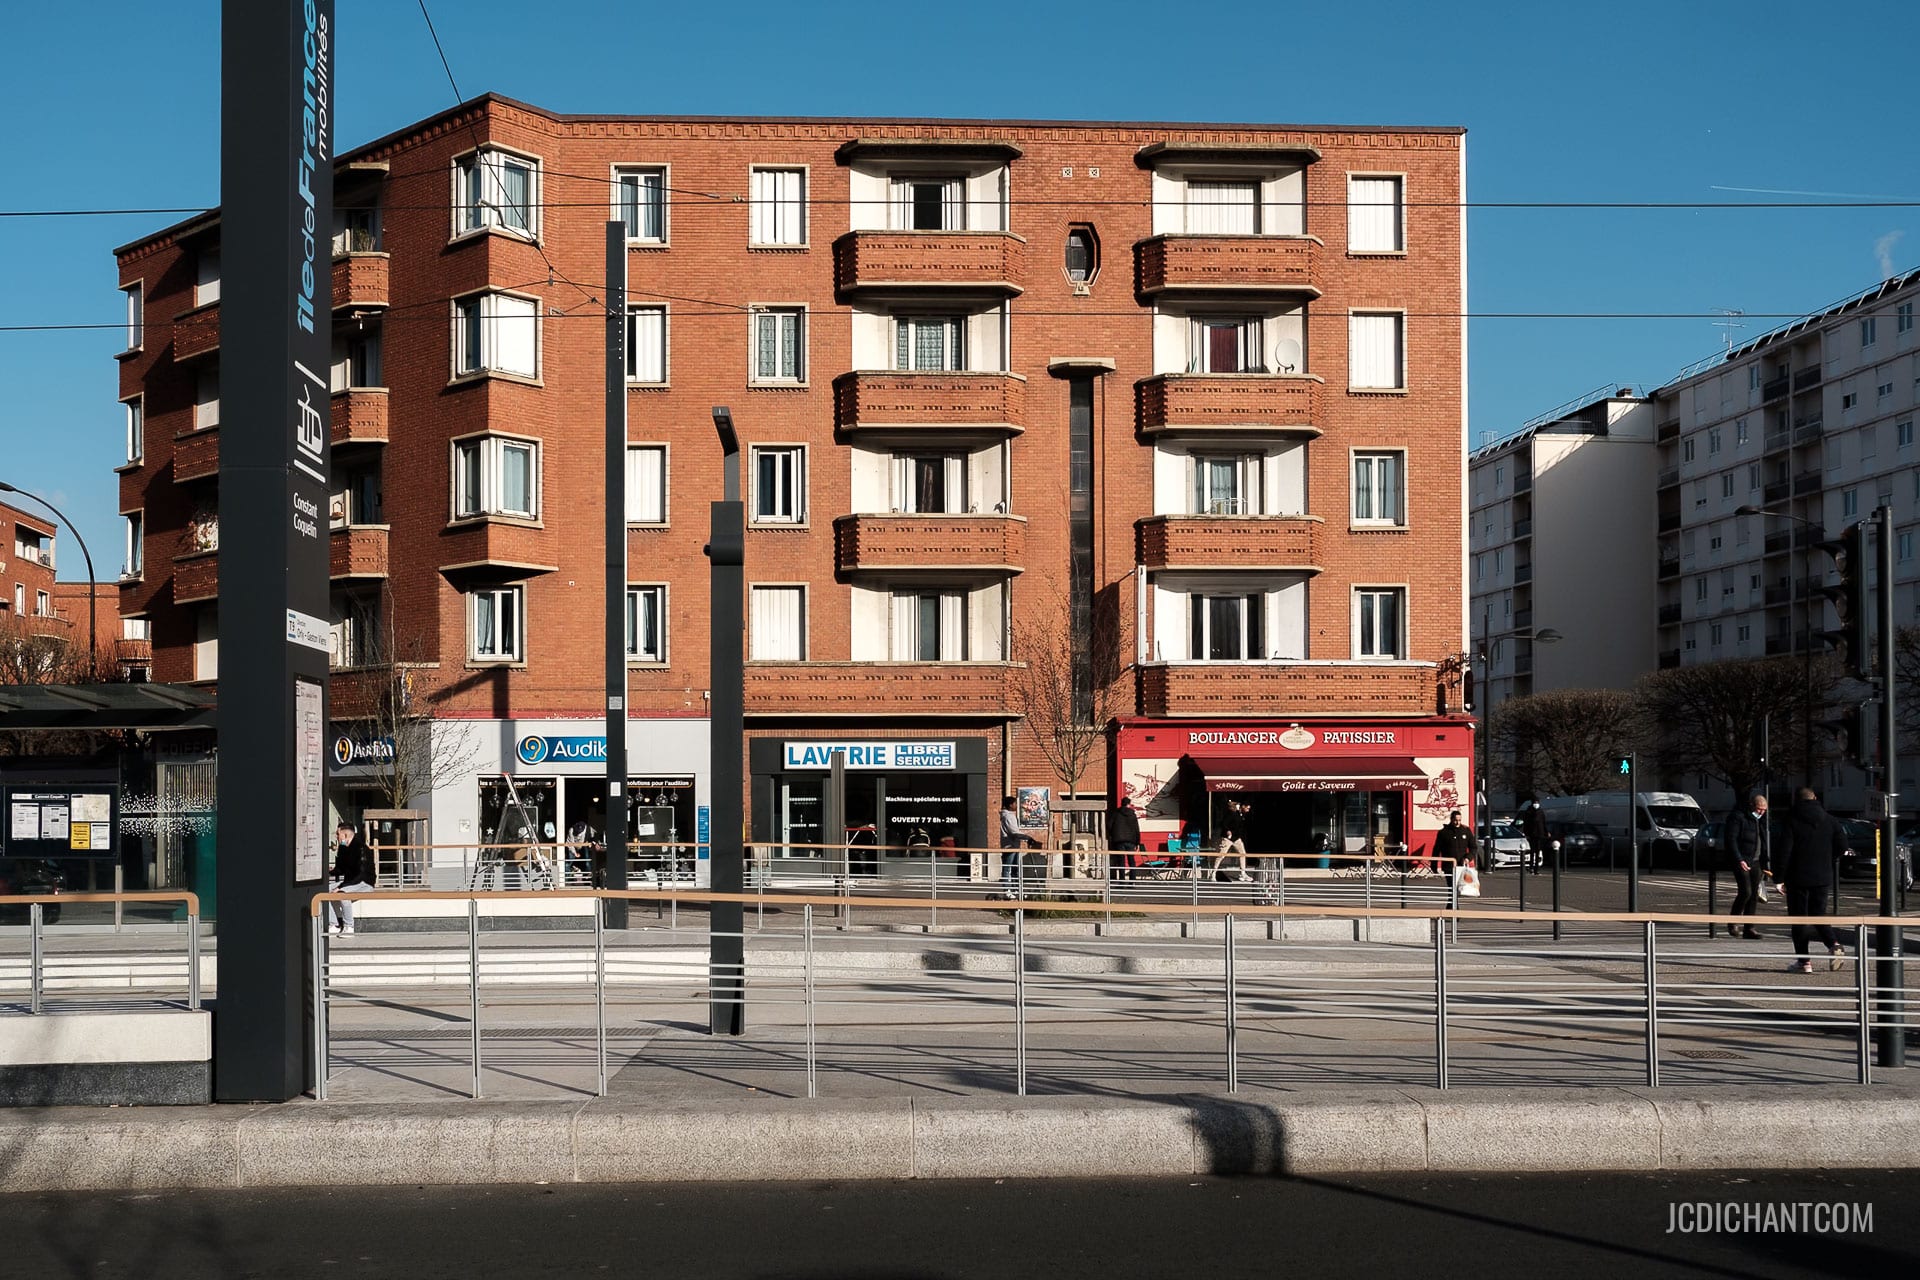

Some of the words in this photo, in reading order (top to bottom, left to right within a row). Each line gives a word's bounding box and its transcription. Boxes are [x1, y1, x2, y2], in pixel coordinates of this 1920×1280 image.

[317, 13, 328, 161] mobilités
[293, 492, 318, 519] Constant
[293, 513, 317, 539] Coquelin
[1189, 732, 1279, 744] BOULANGER
[1323, 732, 1396, 744] PATISSIER
[552, 740, 607, 758] Audik
[897, 745, 950, 755] LIBRE
[897, 755, 950, 765] SERVICE
[1281, 781, 1305, 791] Goût
[1307, 781, 1317, 789] et
[1318, 781, 1356, 790] Saveurs
